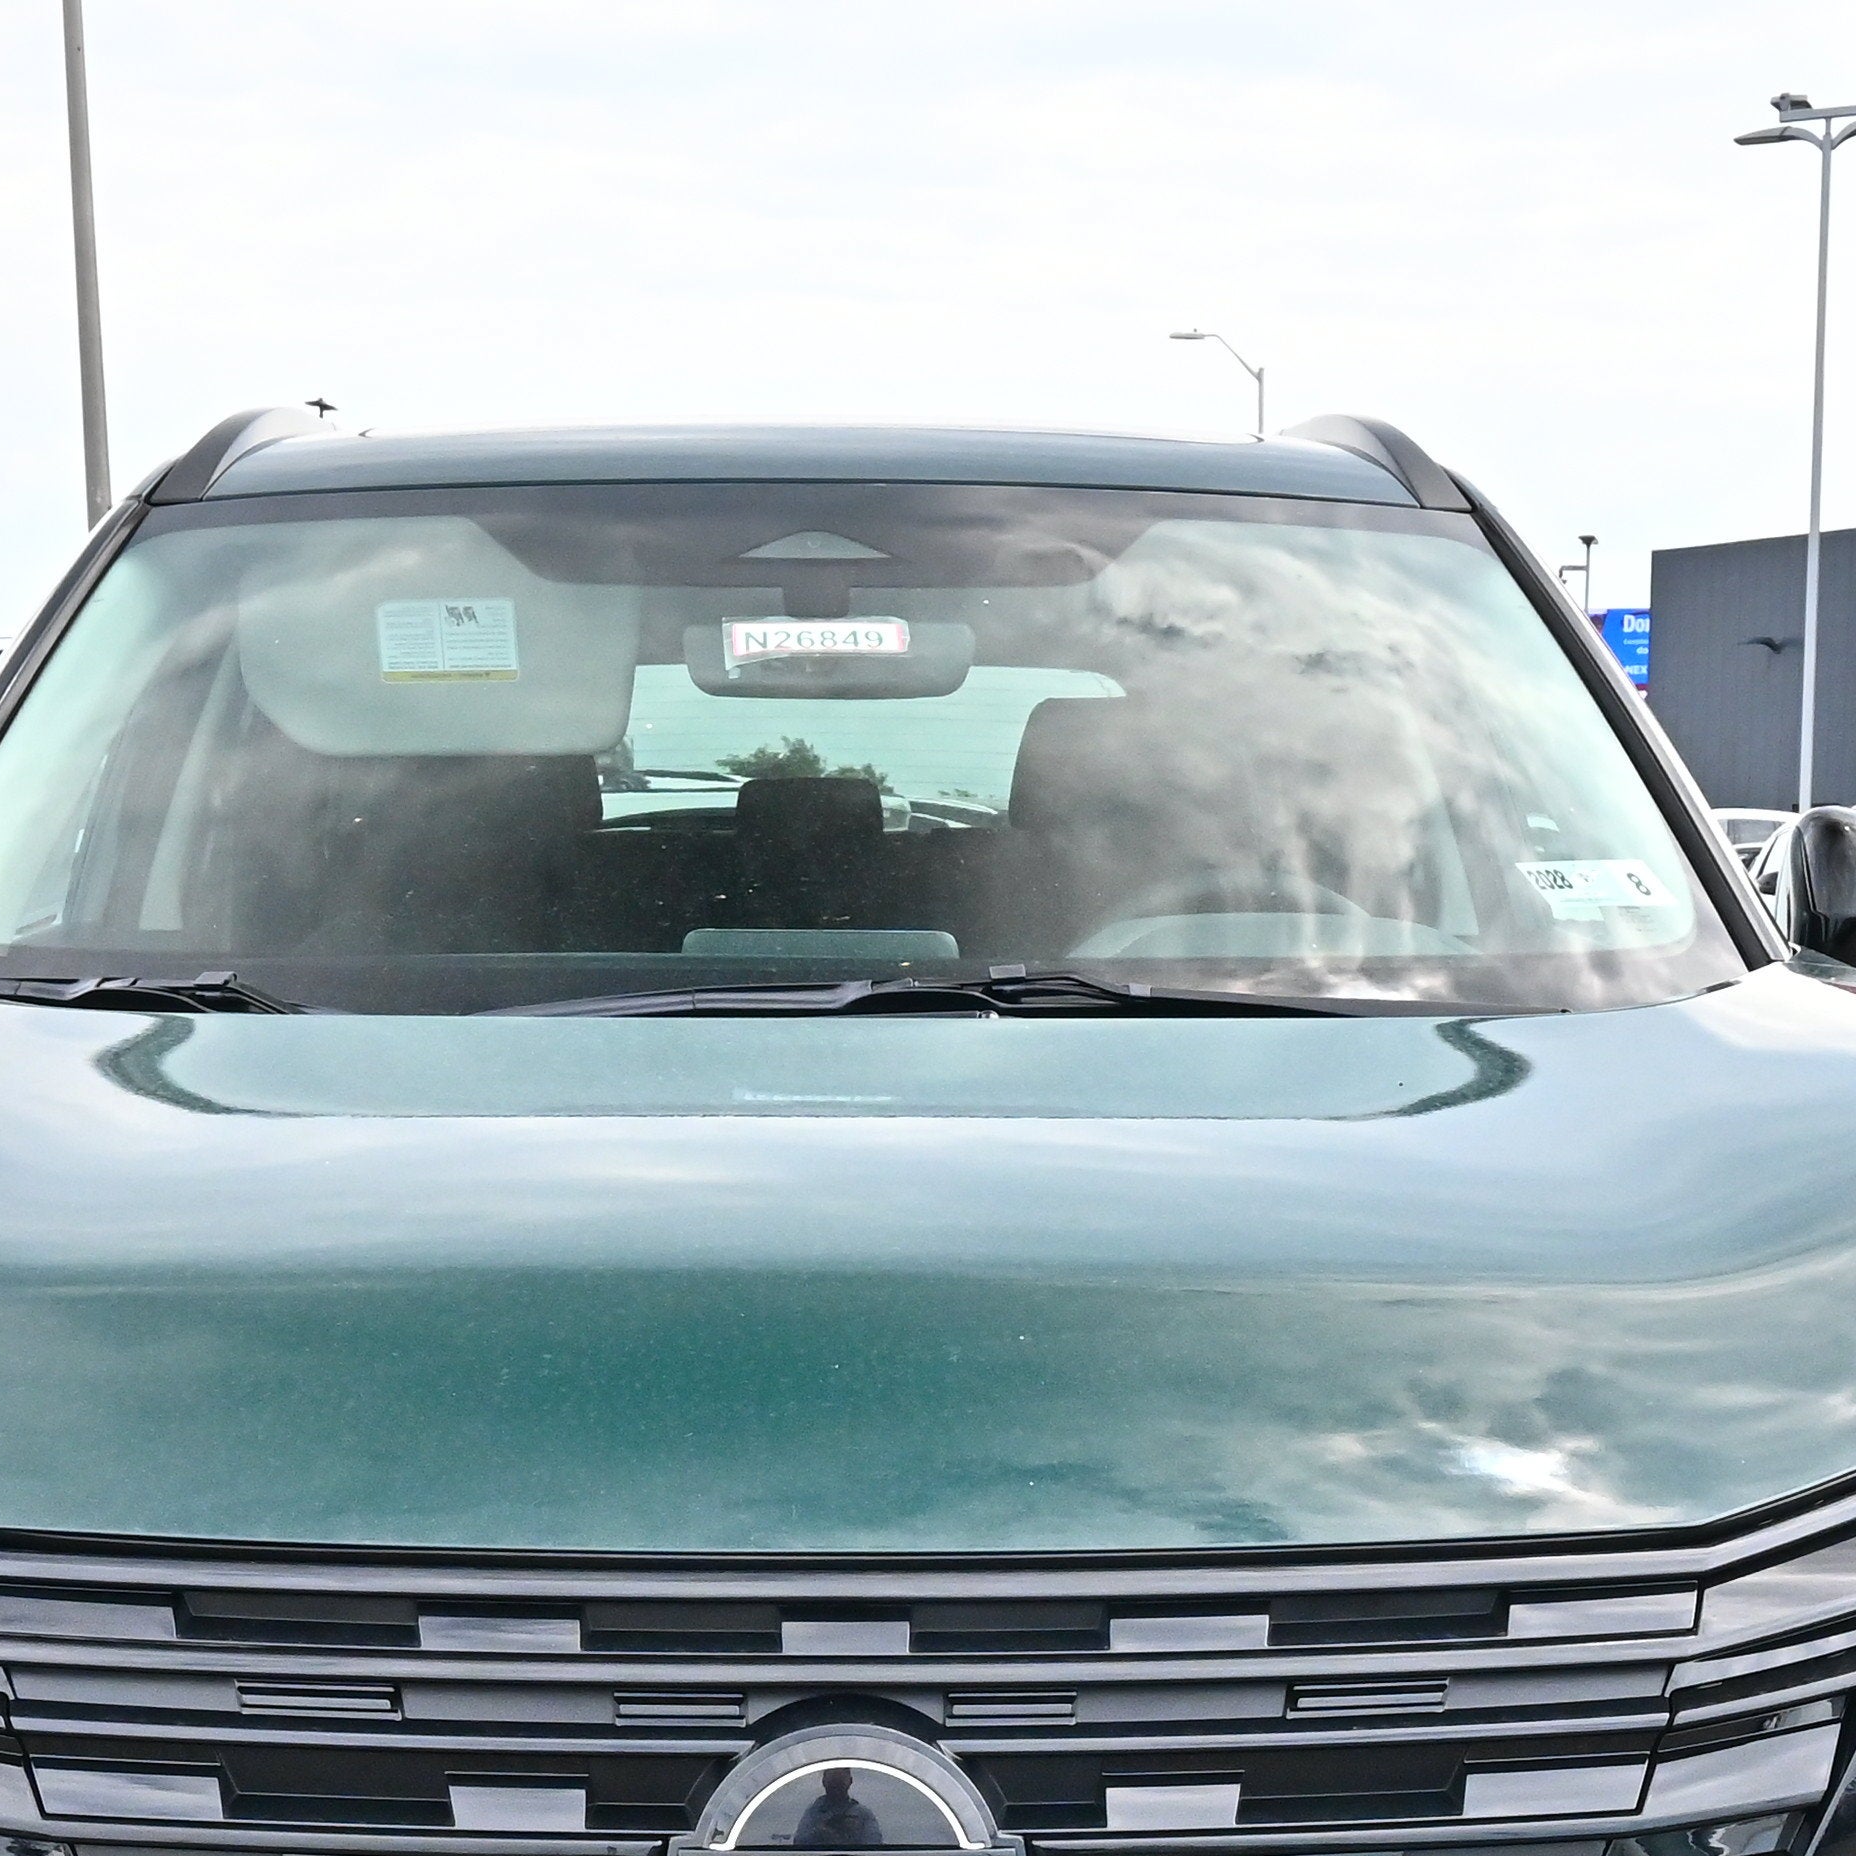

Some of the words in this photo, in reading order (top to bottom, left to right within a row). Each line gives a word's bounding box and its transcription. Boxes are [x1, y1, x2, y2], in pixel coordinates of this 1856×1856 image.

[745, 630, 884, 652] N26849
[1526, 868, 1573, 890] 2028
[1626, 872, 1652, 896] 8
